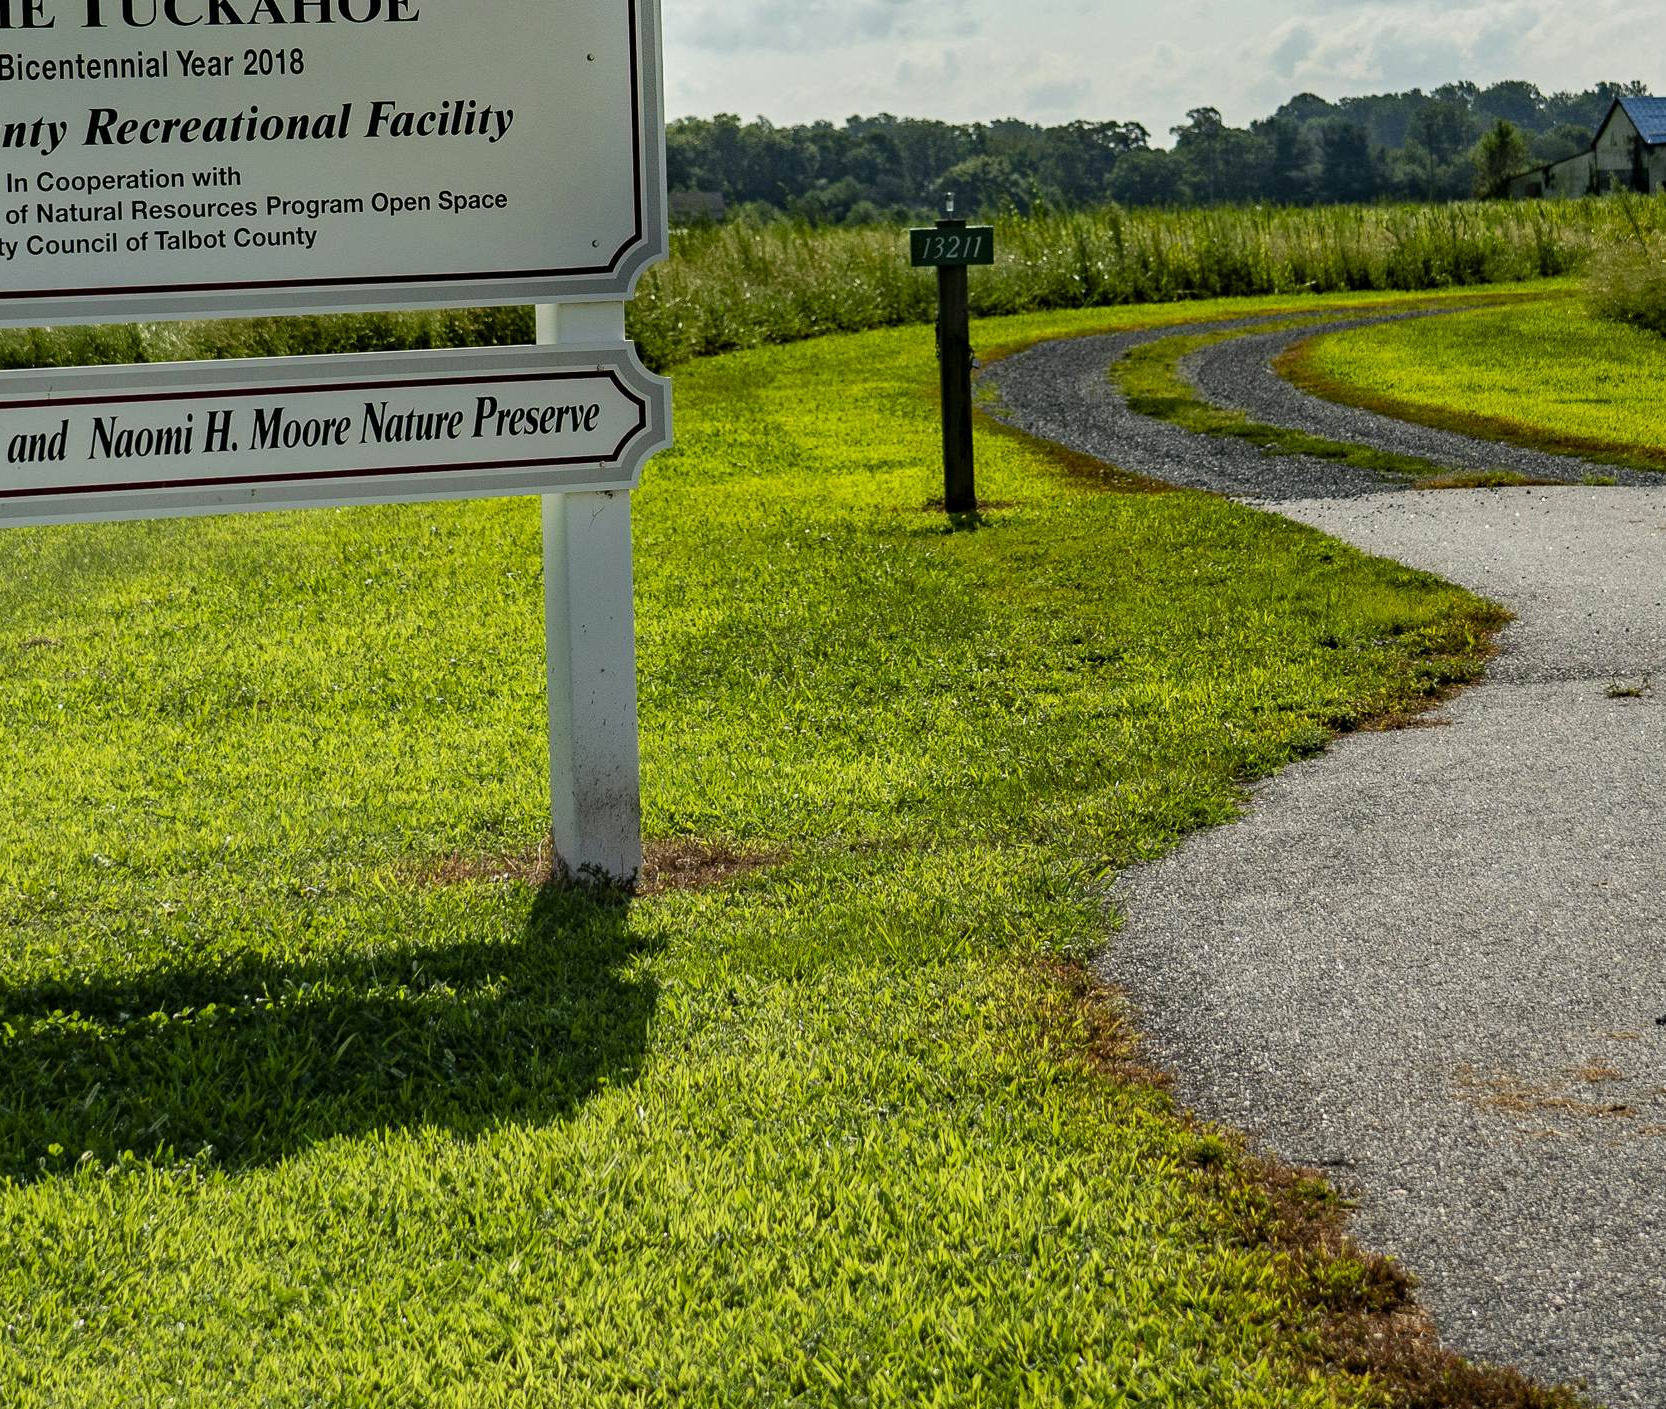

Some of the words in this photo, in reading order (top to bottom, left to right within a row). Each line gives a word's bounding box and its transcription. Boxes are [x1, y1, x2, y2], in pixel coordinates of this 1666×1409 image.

[175, 49, 234, 77] Year
[243, 47, 305, 76] 2018
[81, 102, 353, 146] Recreational
[363, 99, 514, 144] Facility
[6, 172, 28, 193] In
[36, 168, 185, 195] Cooperation
[191, 166, 241, 187] with
[5, 204, 29, 225] of
[36, 200, 123, 224] Natural
[131, 200, 258, 220] Resources
[266, 195, 364, 219] Program
[371, 192, 431, 217] Open
[438, 190, 508, 215] Space
[26, 232, 118, 256] Council
[125, 231, 149, 252] of
[153, 229, 227, 251] Talbot
[233, 226, 318, 250] County
[921, 234, 983, 260] 13211
[7, 418, 70, 464] and
[87, 413, 194, 460] Naomi
[201, 409, 238, 454] H.
[248, 406, 352, 451] Moore
[359, 401, 464, 444] Nature
[470, 396, 600, 438] Preserve
